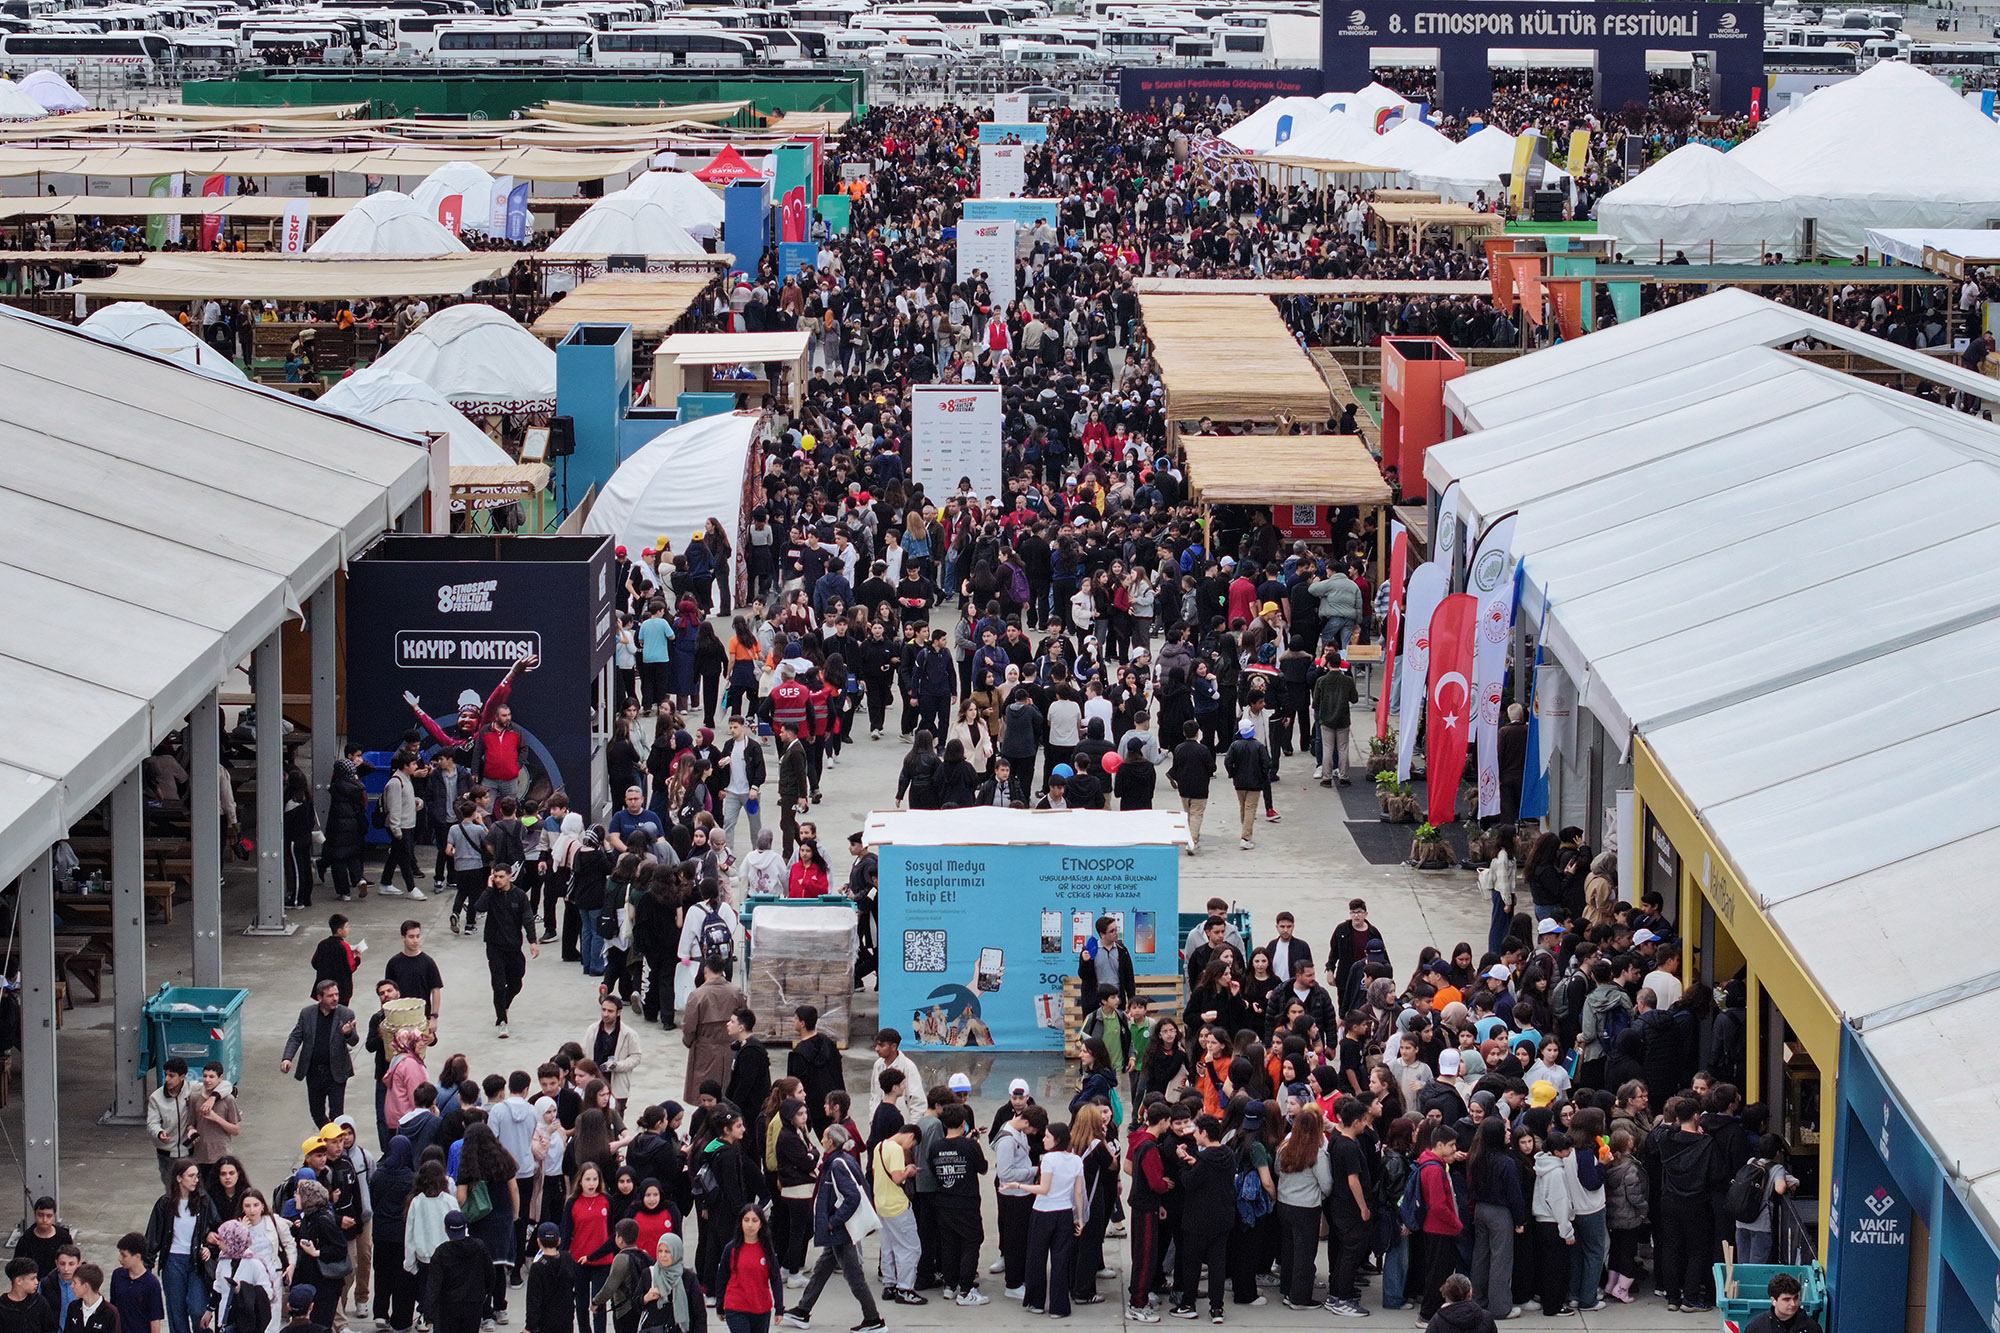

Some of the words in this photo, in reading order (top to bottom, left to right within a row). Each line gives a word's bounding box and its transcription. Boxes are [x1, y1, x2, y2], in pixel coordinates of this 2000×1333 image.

[1389, 13, 1408, 34] 8.
[1415, 13, 1514, 35] ETNOSPOR
[1520, 9, 1597, 35] KÜLTÜR
[1603, 9, 1698, 36] FESTİVALİ
[1141, 81, 1153, 90] Bir
[1155, 80, 1186, 89] Sonraki
[1188, 79, 1231, 88] Festivalde
[1232, 80, 1274, 90] Görüşmek
[1276, 80, 1301, 91] Üzere
[288, 214, 300, 251] OSKF
[438, 585, 454, 613] 8
[453, 580, 498, 594] ETNOSPOR
[402, 640, 456, 660] KAYIP
[460, 640, 534, 661] NOKTASI
[905, 859, 943, 875] Sosyal
[947, 859, 985, 875] Medya
[1062, 857, 1135, 871] ETNOSPOR
[905, 875, 985, 890] Hesaplarımızı
[905, 890, 936, 905] Takip
[940, 890, 956, 902] Et!
[1041, 907, 1047, 915] 1
[1070, 907, 1077, 915] 2
[1101, 907, 1107, 915] 3
[1131, 906, 1138, 915] 4
[1859, 1219, 1898, 1231] VAKIF
[1850, 1231, 1905, 1245] KATILIM
